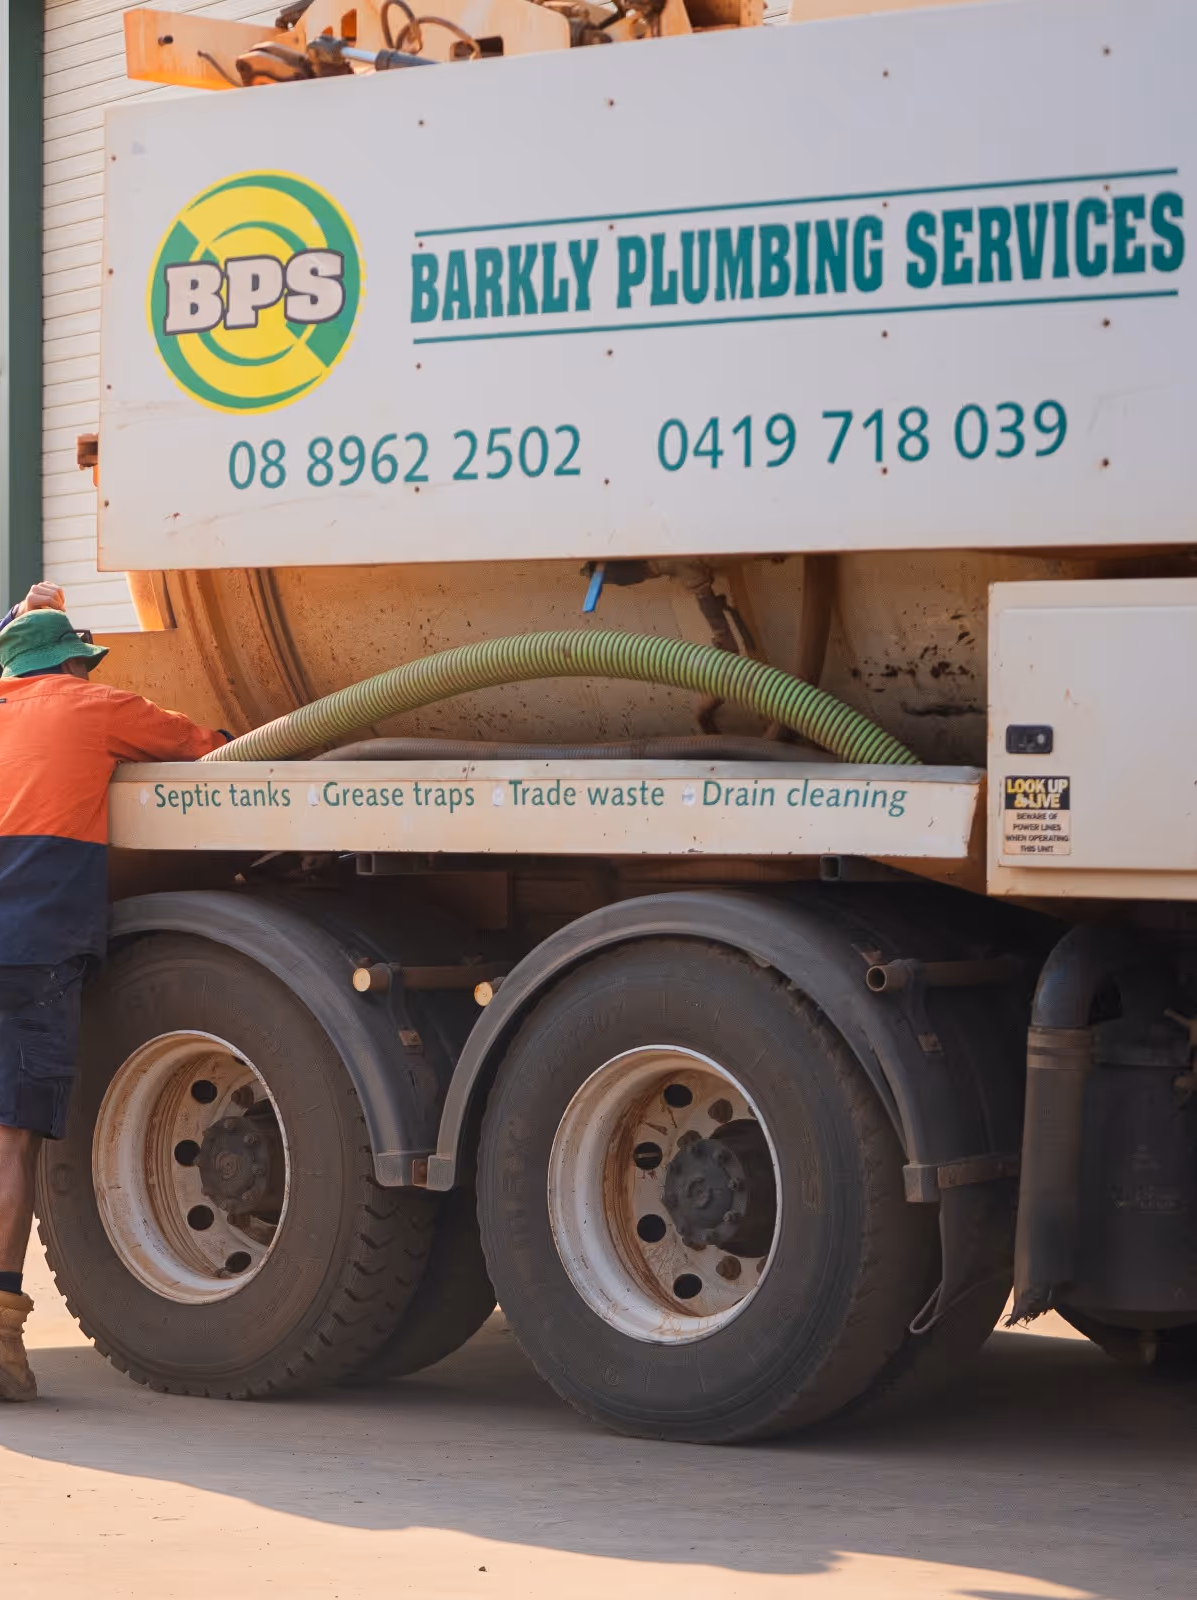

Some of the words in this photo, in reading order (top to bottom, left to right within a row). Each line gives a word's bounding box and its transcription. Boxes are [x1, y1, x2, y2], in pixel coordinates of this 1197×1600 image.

[410, 239, 599, 324] BARKLY
[616, 214, 884, 310] PLUMBING
[905, 190, 1186, 291] SERVICES
[164, 249, 346, 336] BPS
[657, 412, 797, 473] 0419
[821, 405, 930, 465] 718
[954, 399, 1068, 460] 039
[228, 439, 287, 490] 08
[306, 431, 430, 487] 8962
[452, 424, 582, 481] 2502
[154, 783, 222, 814] Septic
[229, 781, 291, 807] tanks
[323, 781, 404, 807] Grease
[413, 782, 475, 813] traps
[508, 778, 577, 806] Trade
[587, 780, 665, 807] waste
[702, 779, 775, 807] Drain
[786, 779, 909, 817] cleaning
[1007, 779, 1045, 793] LOOK
[1048, 779, 1068, 793] UP
